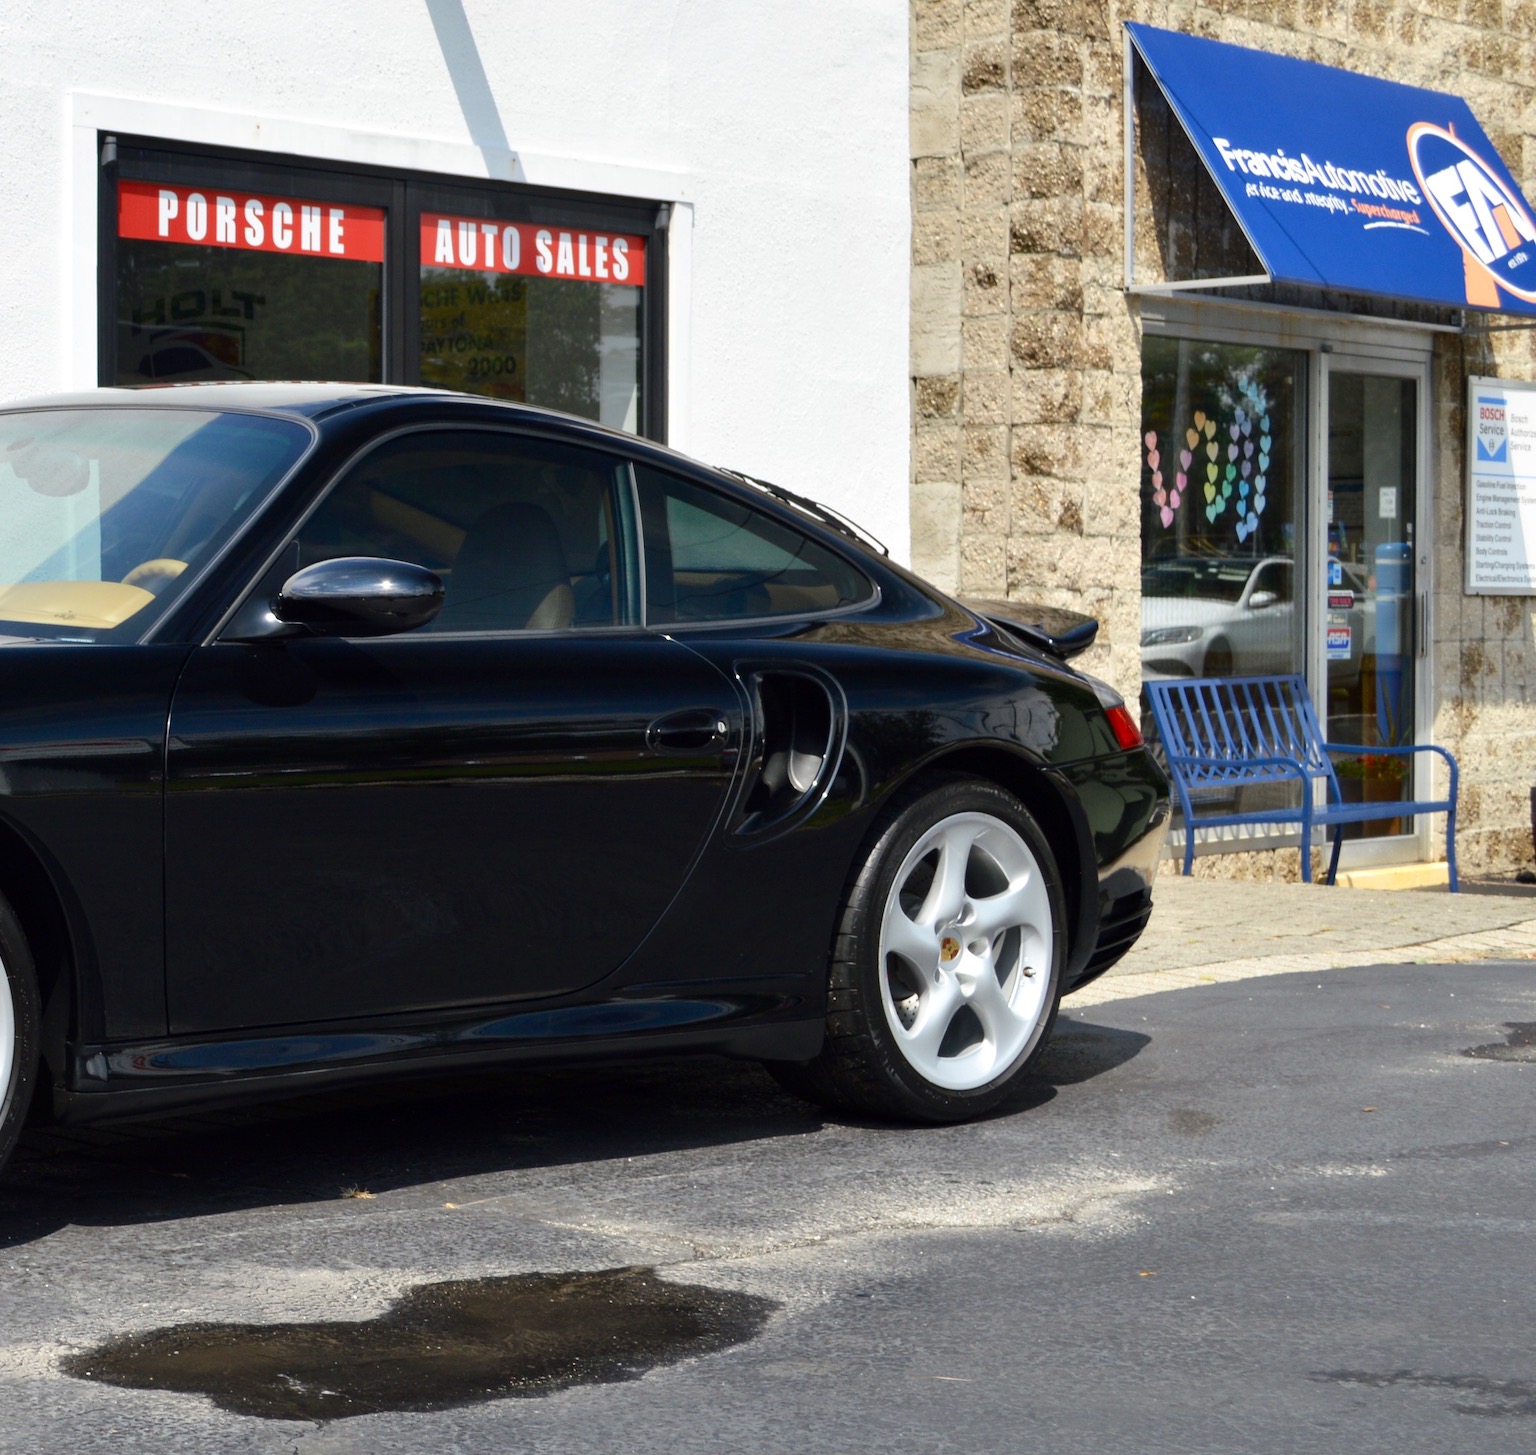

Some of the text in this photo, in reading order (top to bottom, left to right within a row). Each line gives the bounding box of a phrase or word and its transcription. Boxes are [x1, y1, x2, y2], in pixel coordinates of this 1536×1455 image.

[158, 189, 346, 255] PORSCHE
[434, 219, 630, 281] AUTO SALES
[467, 355, 517, 377] 2000
[1479, 406, 1505, 421] BOSCH
[1479, 422, 1505, 436] Service
[1510, 440, 1532, 452] Service
